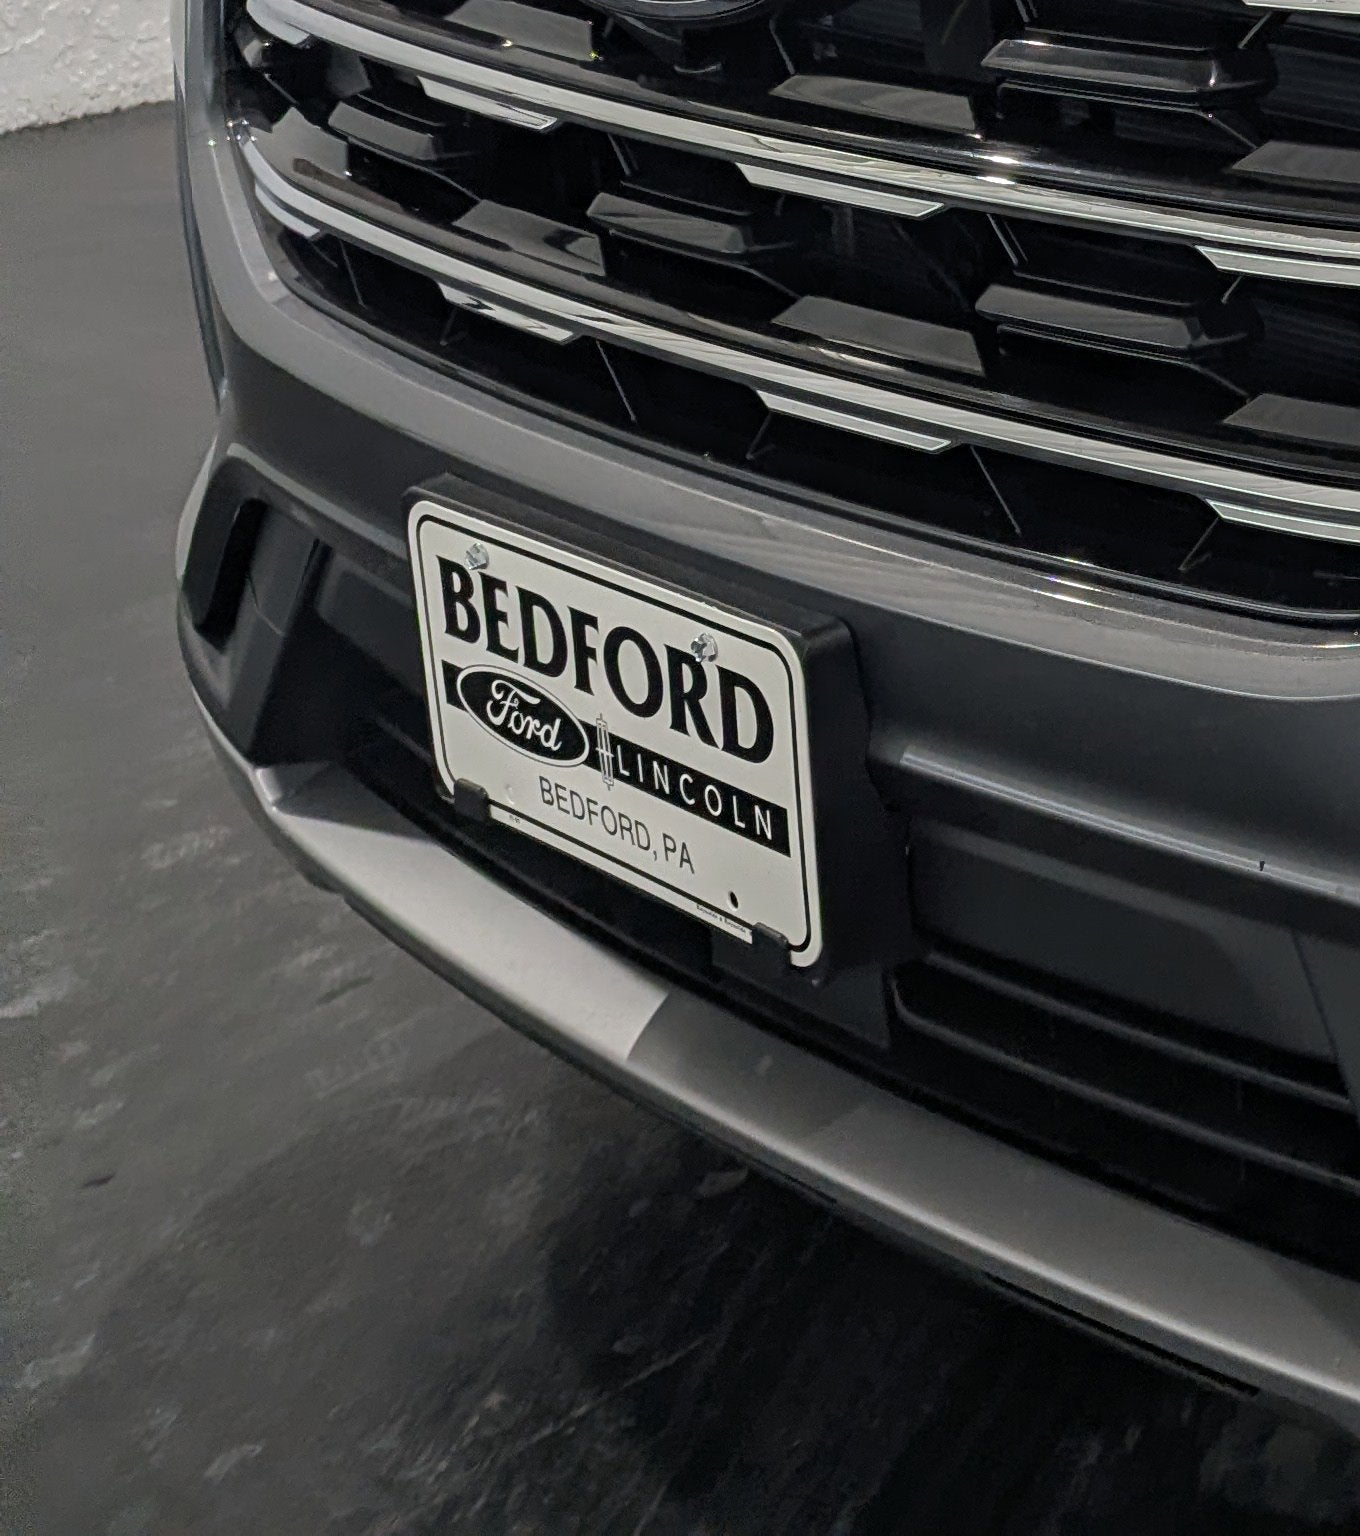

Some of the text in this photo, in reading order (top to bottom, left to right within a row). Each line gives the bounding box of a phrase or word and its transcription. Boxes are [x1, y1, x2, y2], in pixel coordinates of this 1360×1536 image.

[436, 554, 775, 764] BEDFORD
[486, 679, 774, 841] Ford LINCOLN
[662, 832, 696, 875] PA
